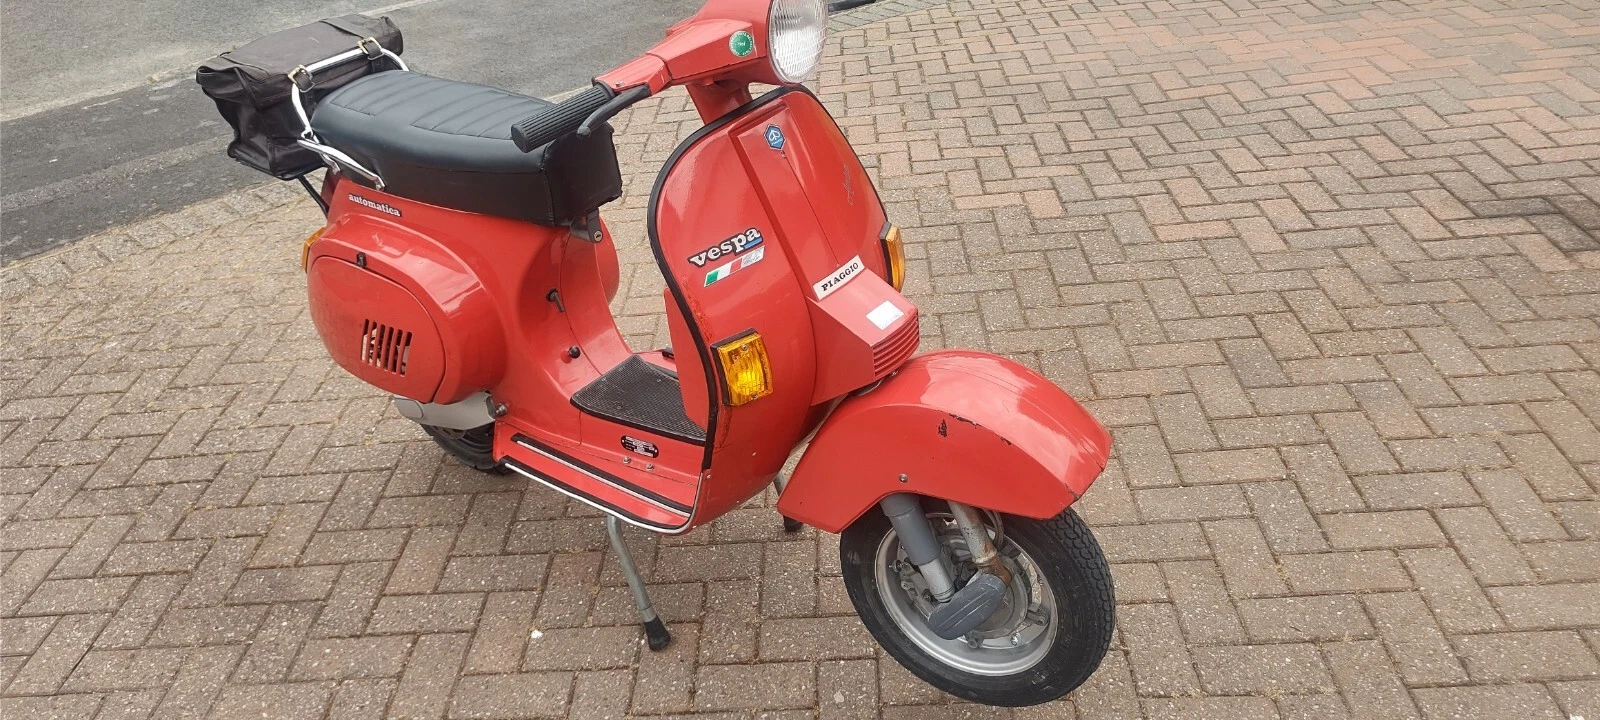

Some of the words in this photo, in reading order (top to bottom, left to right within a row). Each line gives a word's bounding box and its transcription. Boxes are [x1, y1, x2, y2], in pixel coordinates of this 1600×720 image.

[349, 194, 400, 217] automatica
[689, 227, 762, 267] vespa
[820, 262, 859, 292] PIAGGIO
